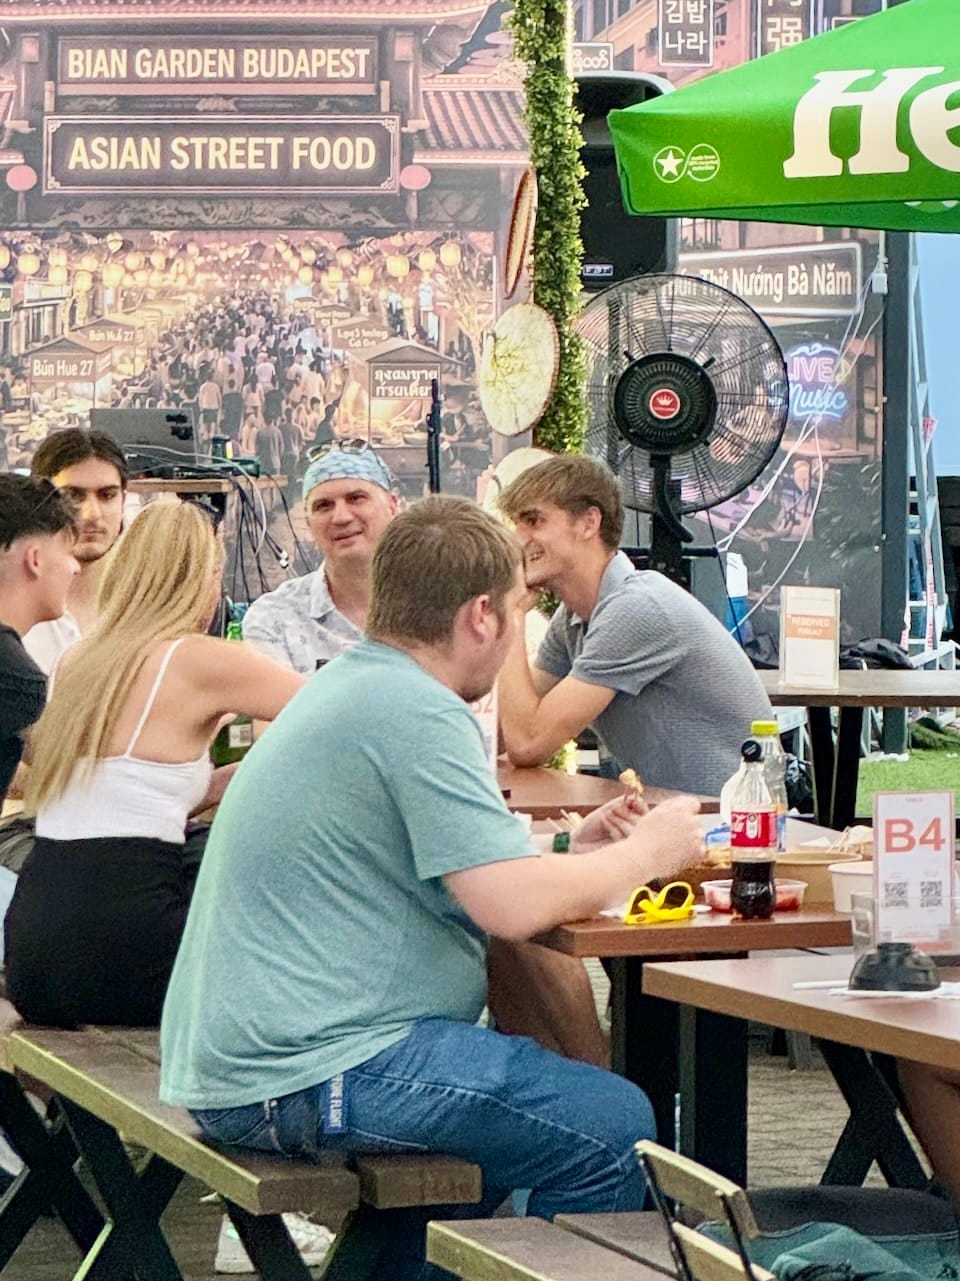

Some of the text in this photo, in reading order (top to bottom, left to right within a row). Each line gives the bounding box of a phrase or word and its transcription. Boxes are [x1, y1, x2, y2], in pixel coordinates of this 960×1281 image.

[665, 0, 707, 24] 김밥
[665, 31, 707, 55] 나라
[68, 48, 370, 78] BIAN GARDEN BUDAPEST
[68, 136, 376, 170] ASIAN STREET FOOD
[788, 264, 809, 296] Bà
[812, 262, 852, 296] Năm
[33, 359, 54, 376] Bún
[80, 359, 94, 376] 27
[884, 816, 946, 853] B4
